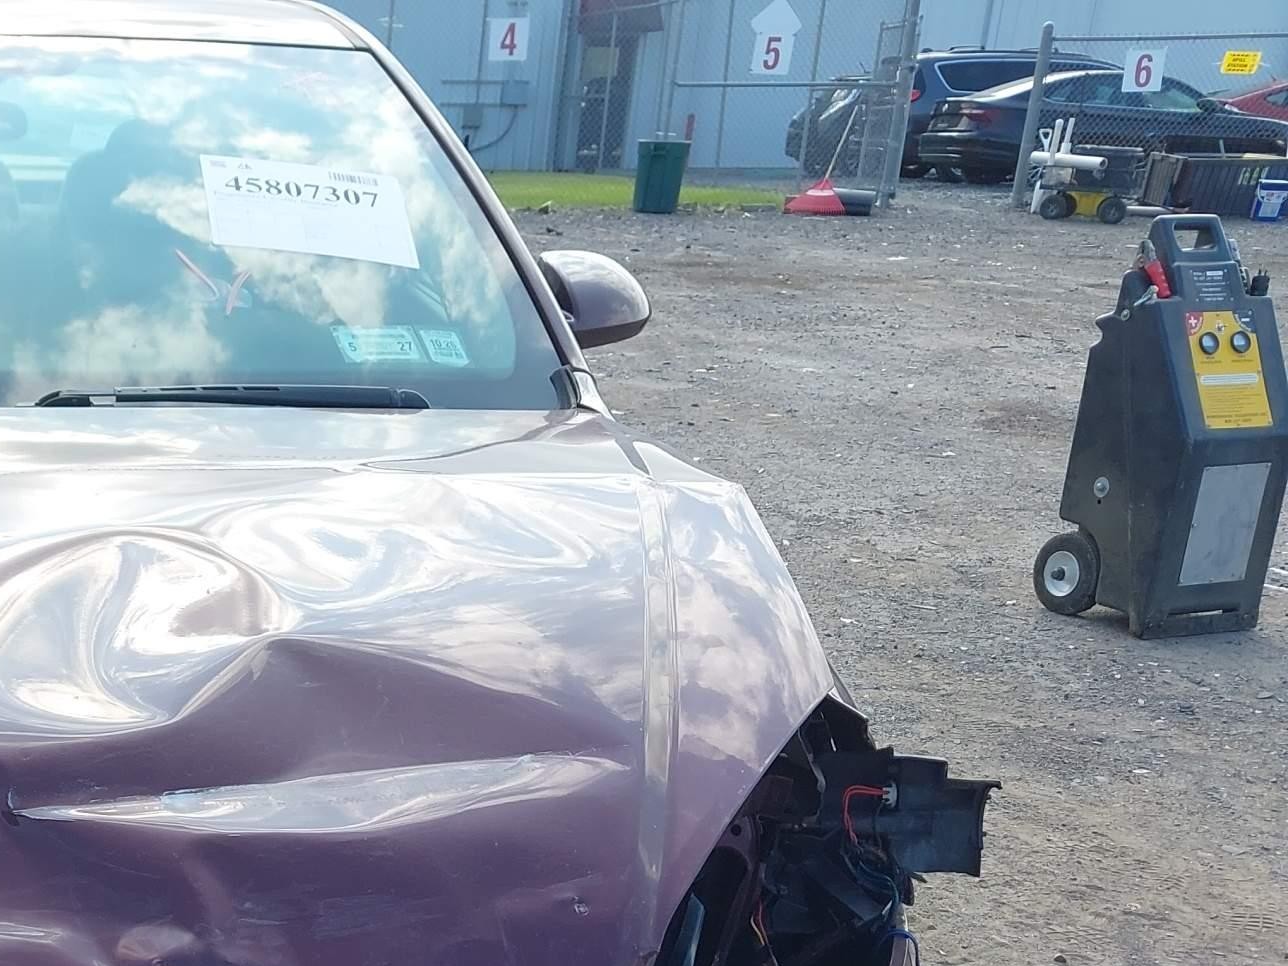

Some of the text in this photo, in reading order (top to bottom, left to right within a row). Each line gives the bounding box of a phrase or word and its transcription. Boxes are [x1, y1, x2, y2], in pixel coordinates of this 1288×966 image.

[500, 22, 517, 56] 4
[763, 36, 782, 70] 5
[1134, 53, 1153, 88] 6
[225, 176, 378, 207] 45807307
[397, 340, 412, 352] 27
